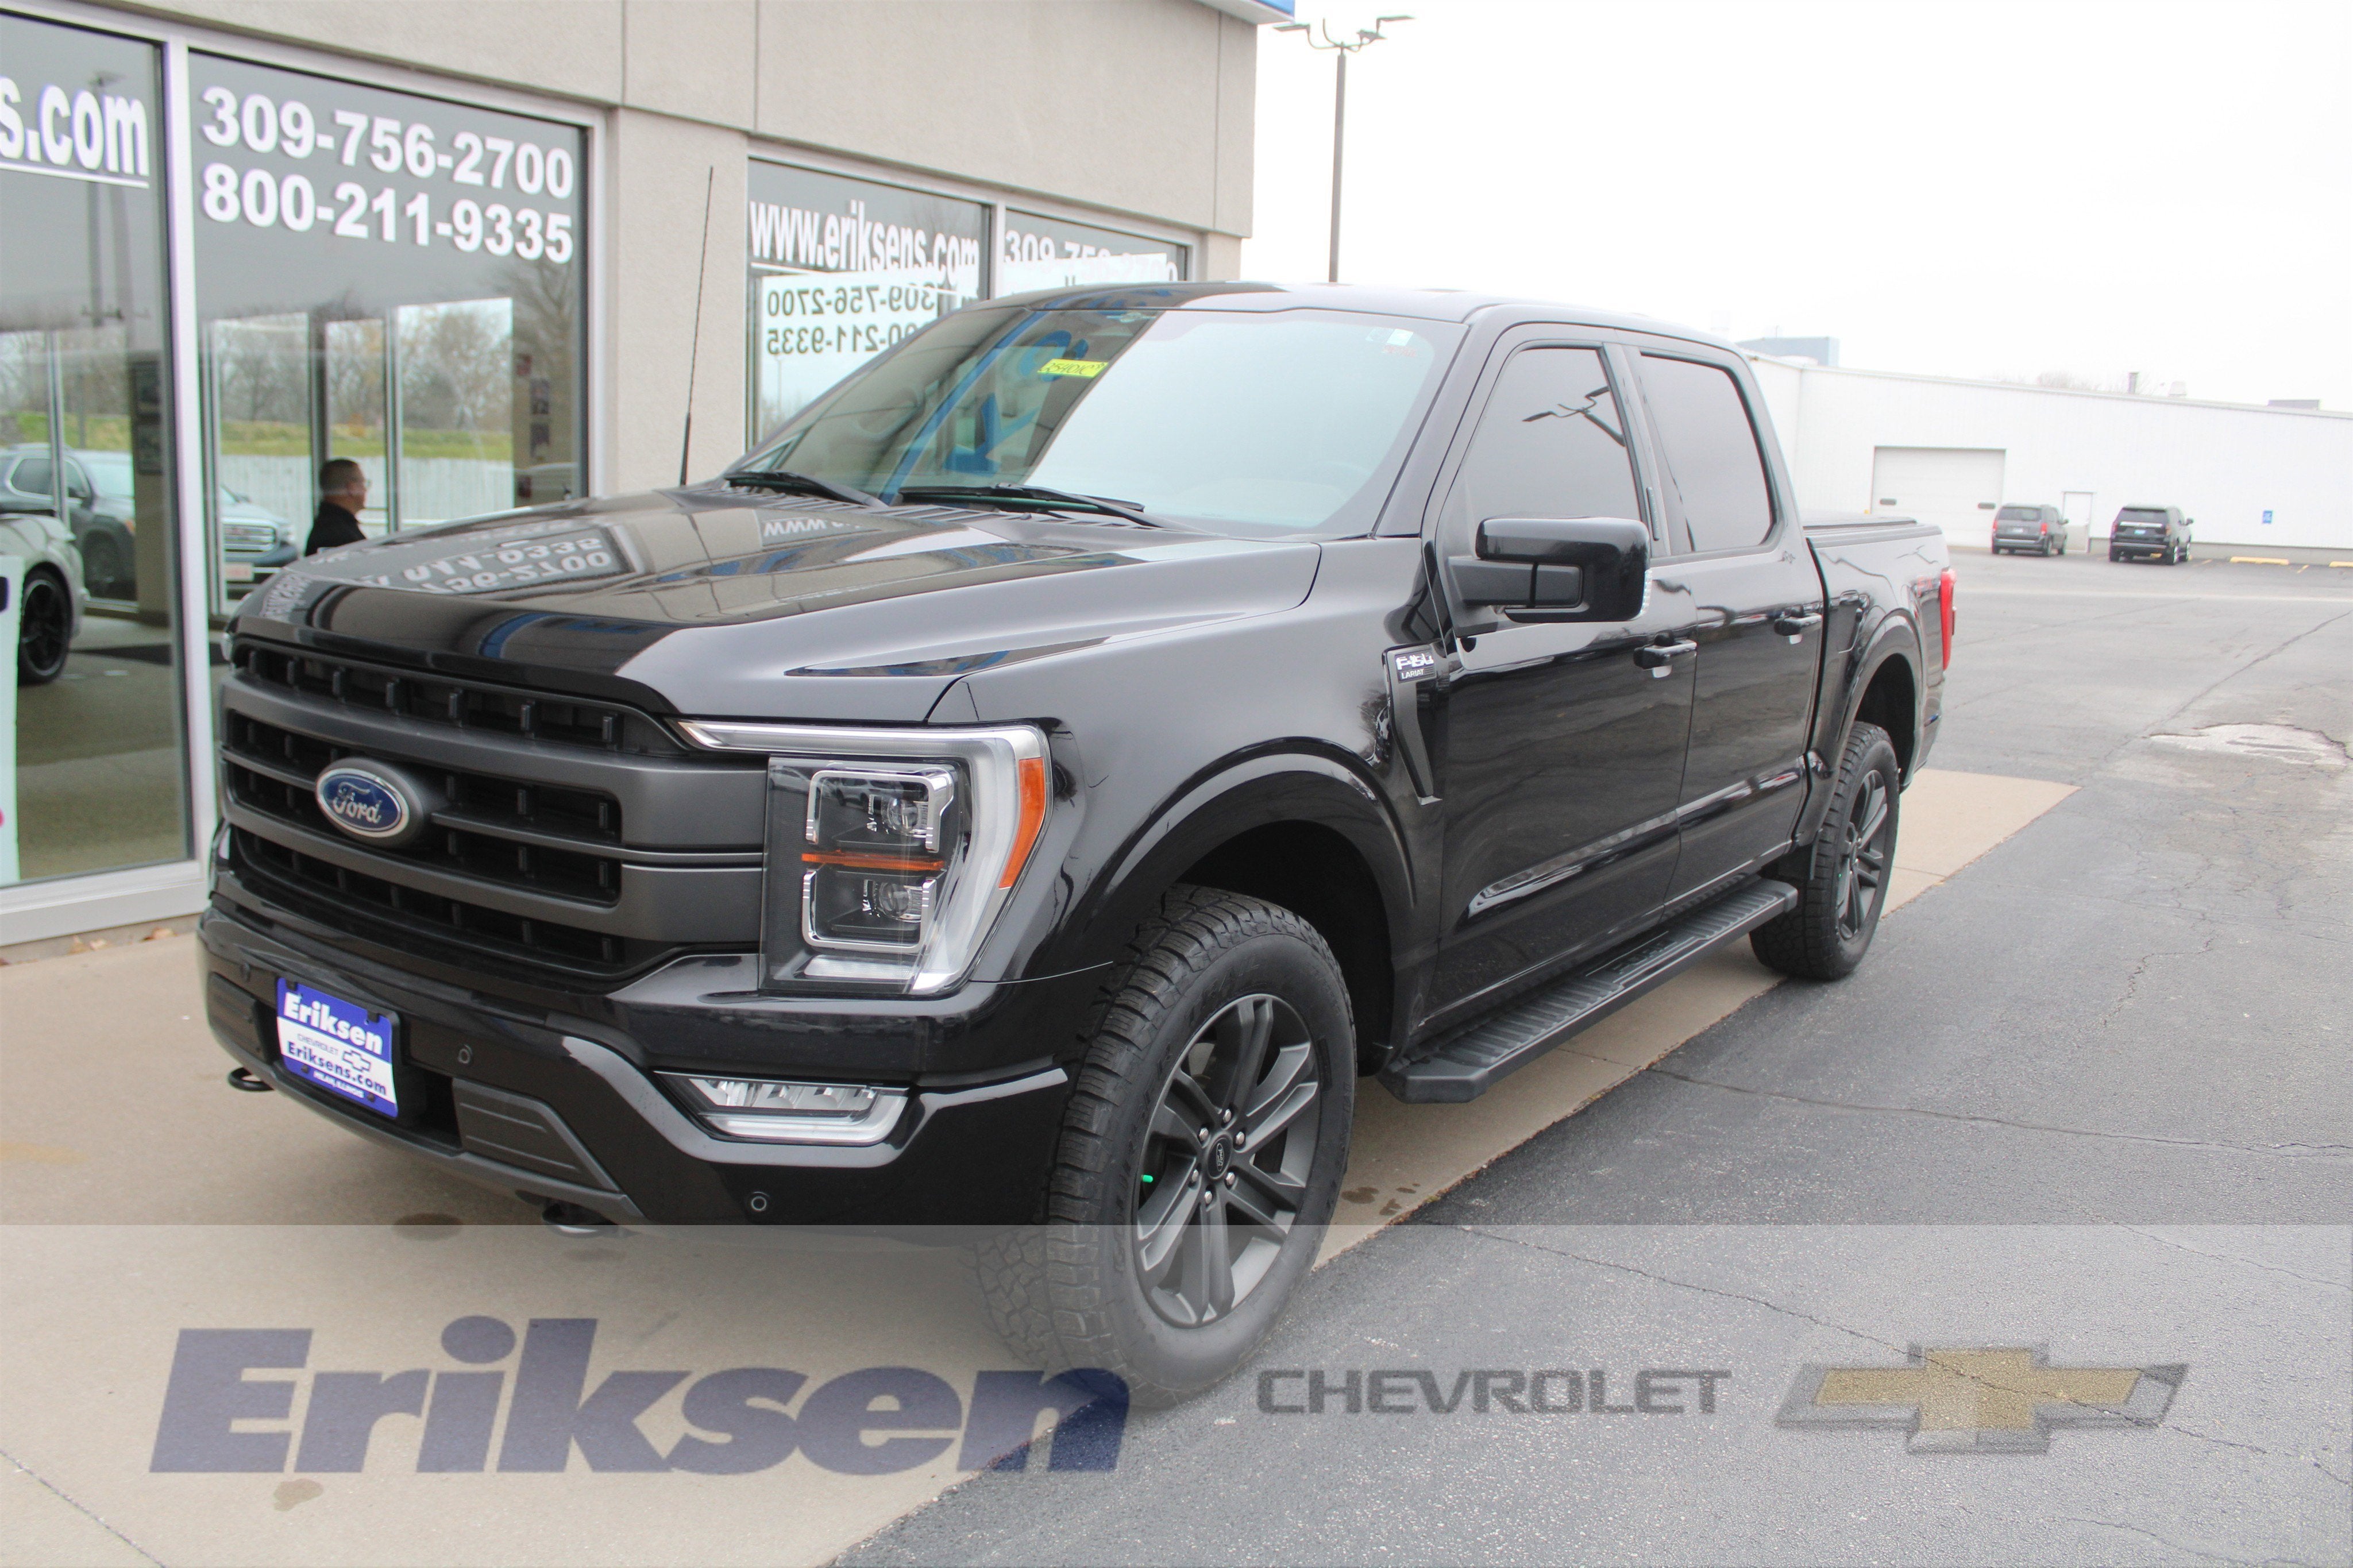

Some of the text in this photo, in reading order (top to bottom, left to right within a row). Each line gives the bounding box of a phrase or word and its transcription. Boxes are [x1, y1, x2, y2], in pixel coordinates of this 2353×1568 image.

[202, 86, 573, 199] 309-756-2700
[202, 163, 573, 264] 800-211-9335
[750, 199, 980, 291] www.eriksens.com
[1401, 669, 1425, 679] LARIAT
[333, 781, 383, 824] Ford
[284, 991, 383, 1055] Eriksen
[288, 1041, 387, 1095] Eriksens.com
